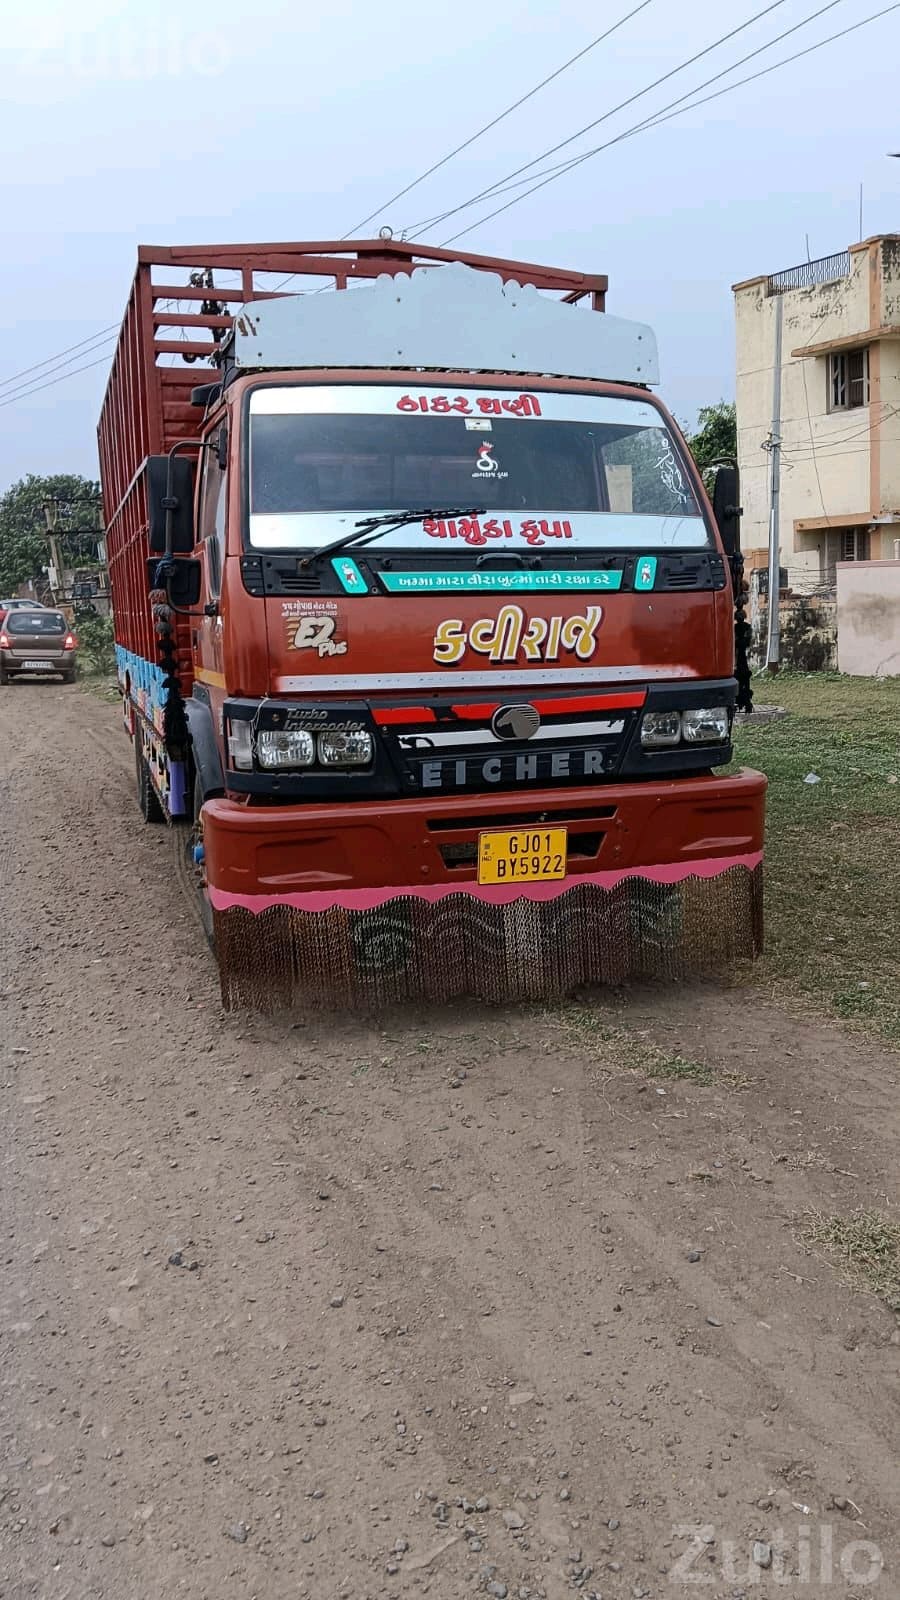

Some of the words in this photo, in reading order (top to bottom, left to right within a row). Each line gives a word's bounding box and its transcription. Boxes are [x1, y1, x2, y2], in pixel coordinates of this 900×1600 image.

[396, 394, 473, 415] ઠાકર
[423, 512, 513, 546] ચામુંડા
[520, 519, 573, 546] કૃપા
[435, 576, 464, 585] મારા
[467, 573, 495, 585] વીરા
[535, 573, 562, 585] તારી
[564, 575, 590, 585] રક્ષા
[593, 573, 611, 585] કરે
[433, 604, 603, 664] કવીરાજ
[287, 708, 328, 719] Turbo
[283, 720, 366, 731] Intercooler
[422, 750, 606, 788] EICHER
[509, 833, 551, 854] GJ01
[497, 854, 563, 878] BY5922
